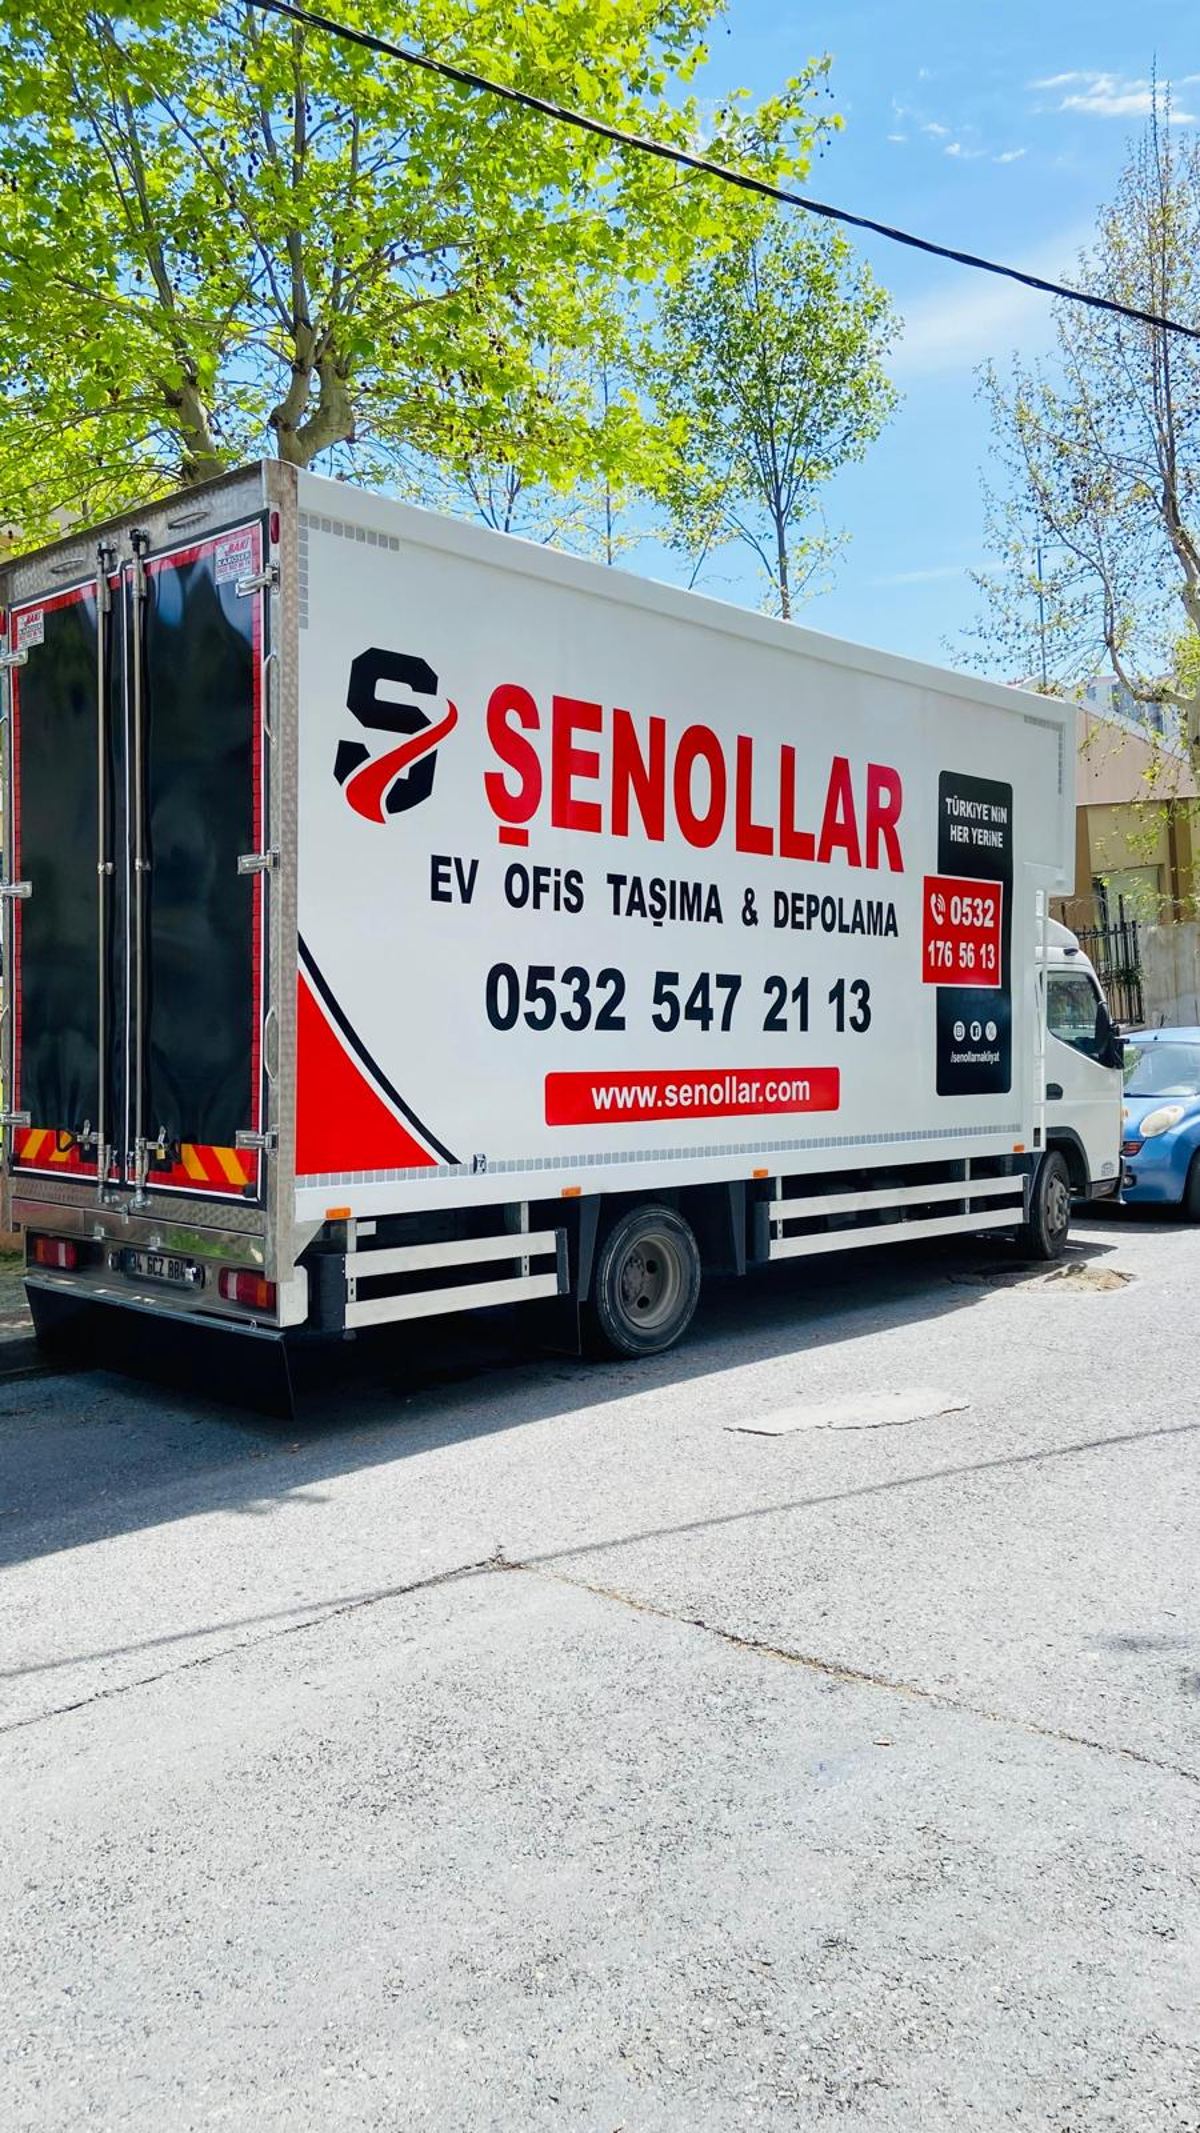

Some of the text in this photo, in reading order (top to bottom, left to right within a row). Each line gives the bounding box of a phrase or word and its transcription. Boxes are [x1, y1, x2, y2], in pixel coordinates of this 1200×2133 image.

[483, 683, 905, 874] ŞENOLLAR
[950, 824, 970, 844] HER
[430, 854, 480, 904] EV
[606, 873, 724, 928] TAŞIMA
[741, 887, 759, 927] &
[773, 890, 900, 938] DEPOLAMA
[950, 895, 995, 928] 0532
[927, 939, 996, 970] 176 56 13
[485, 962, 872, 1033] 0532 547 21 13
[591, 1076, 811, 1111] www.senollar.com
